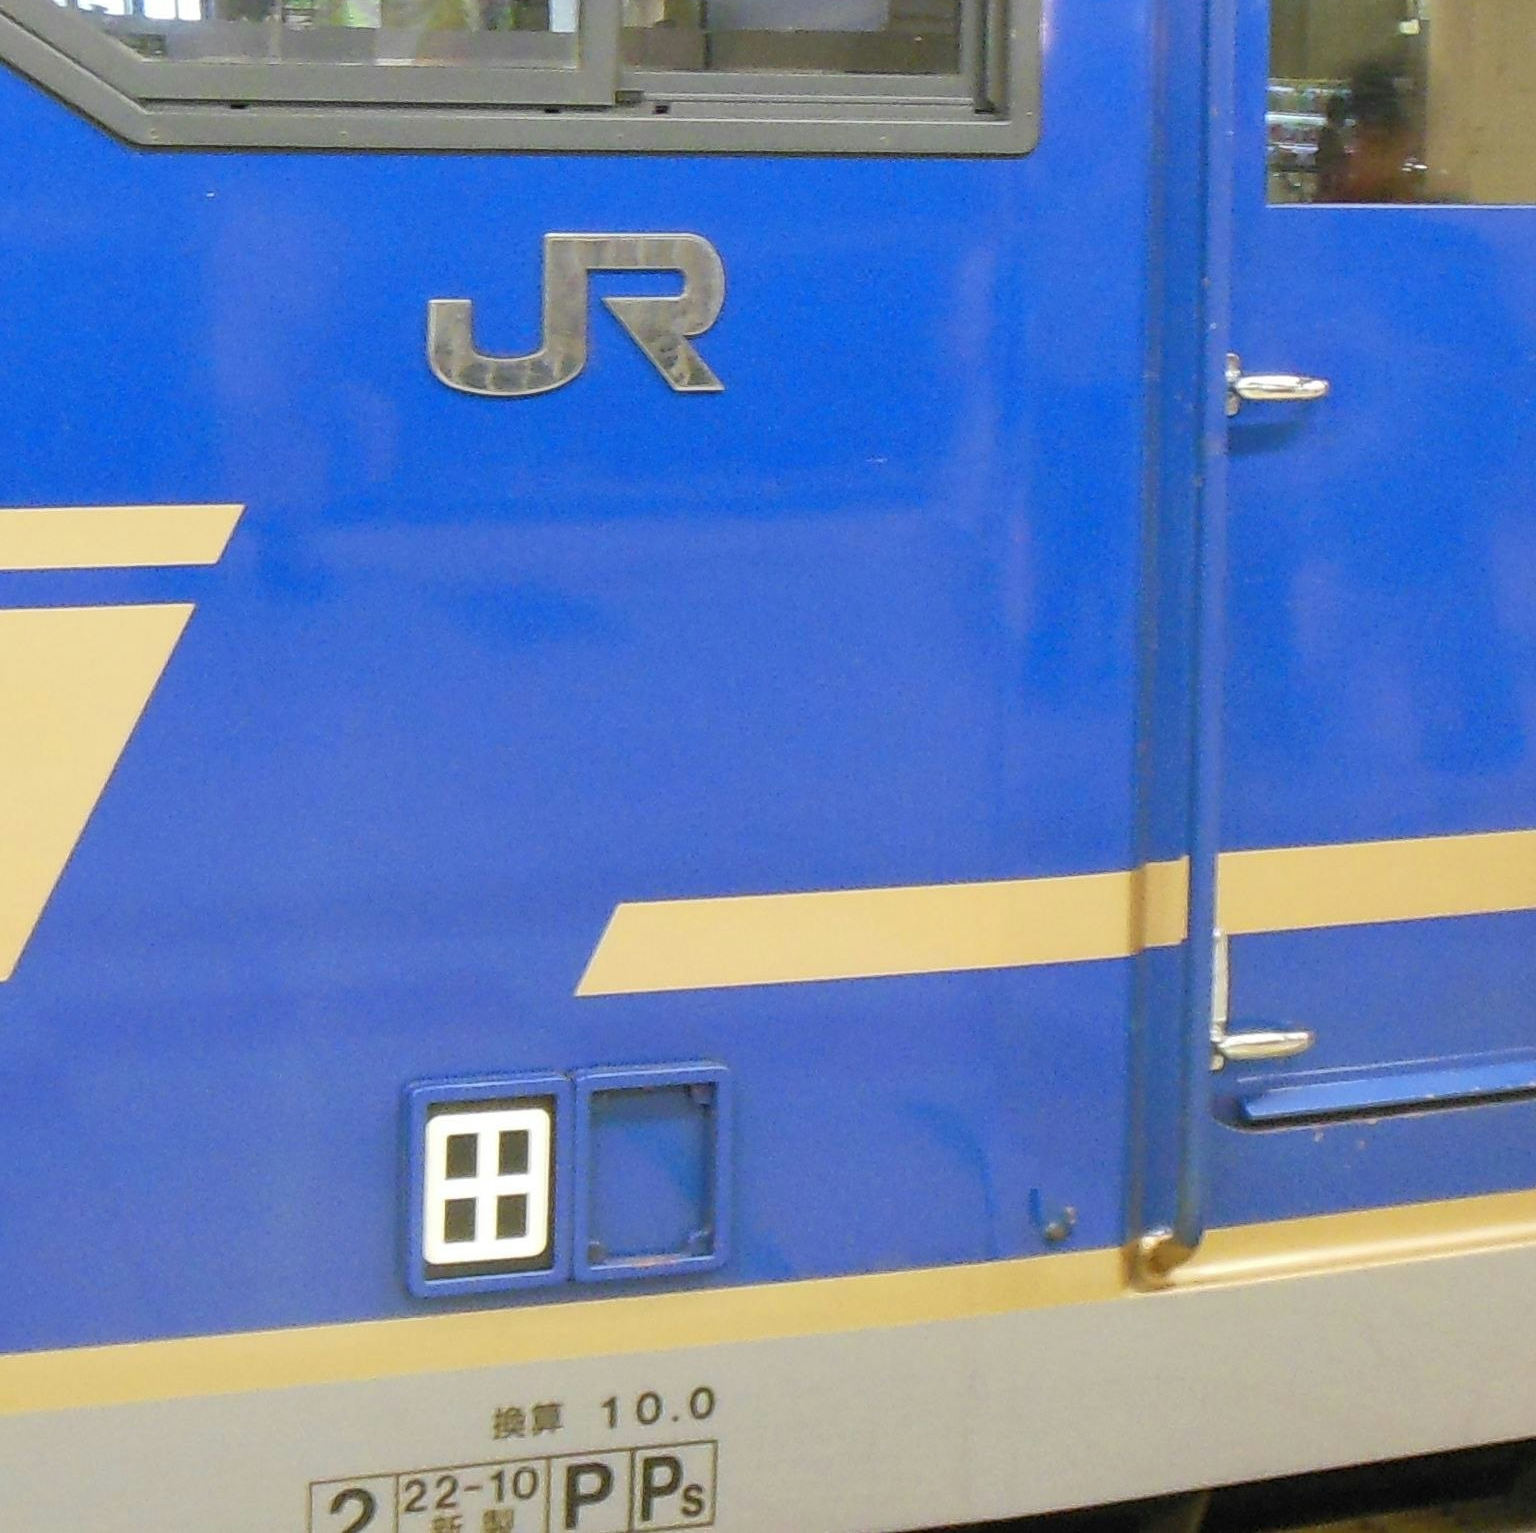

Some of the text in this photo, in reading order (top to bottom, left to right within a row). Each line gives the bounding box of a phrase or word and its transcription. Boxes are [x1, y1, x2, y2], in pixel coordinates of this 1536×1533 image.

[426, 231, 726, 397] JR
[600, 1385, 717, 1430] 10.0
[403, 1466, 540, 1514] 22-10
[564, 1461, 614, 1531] P
